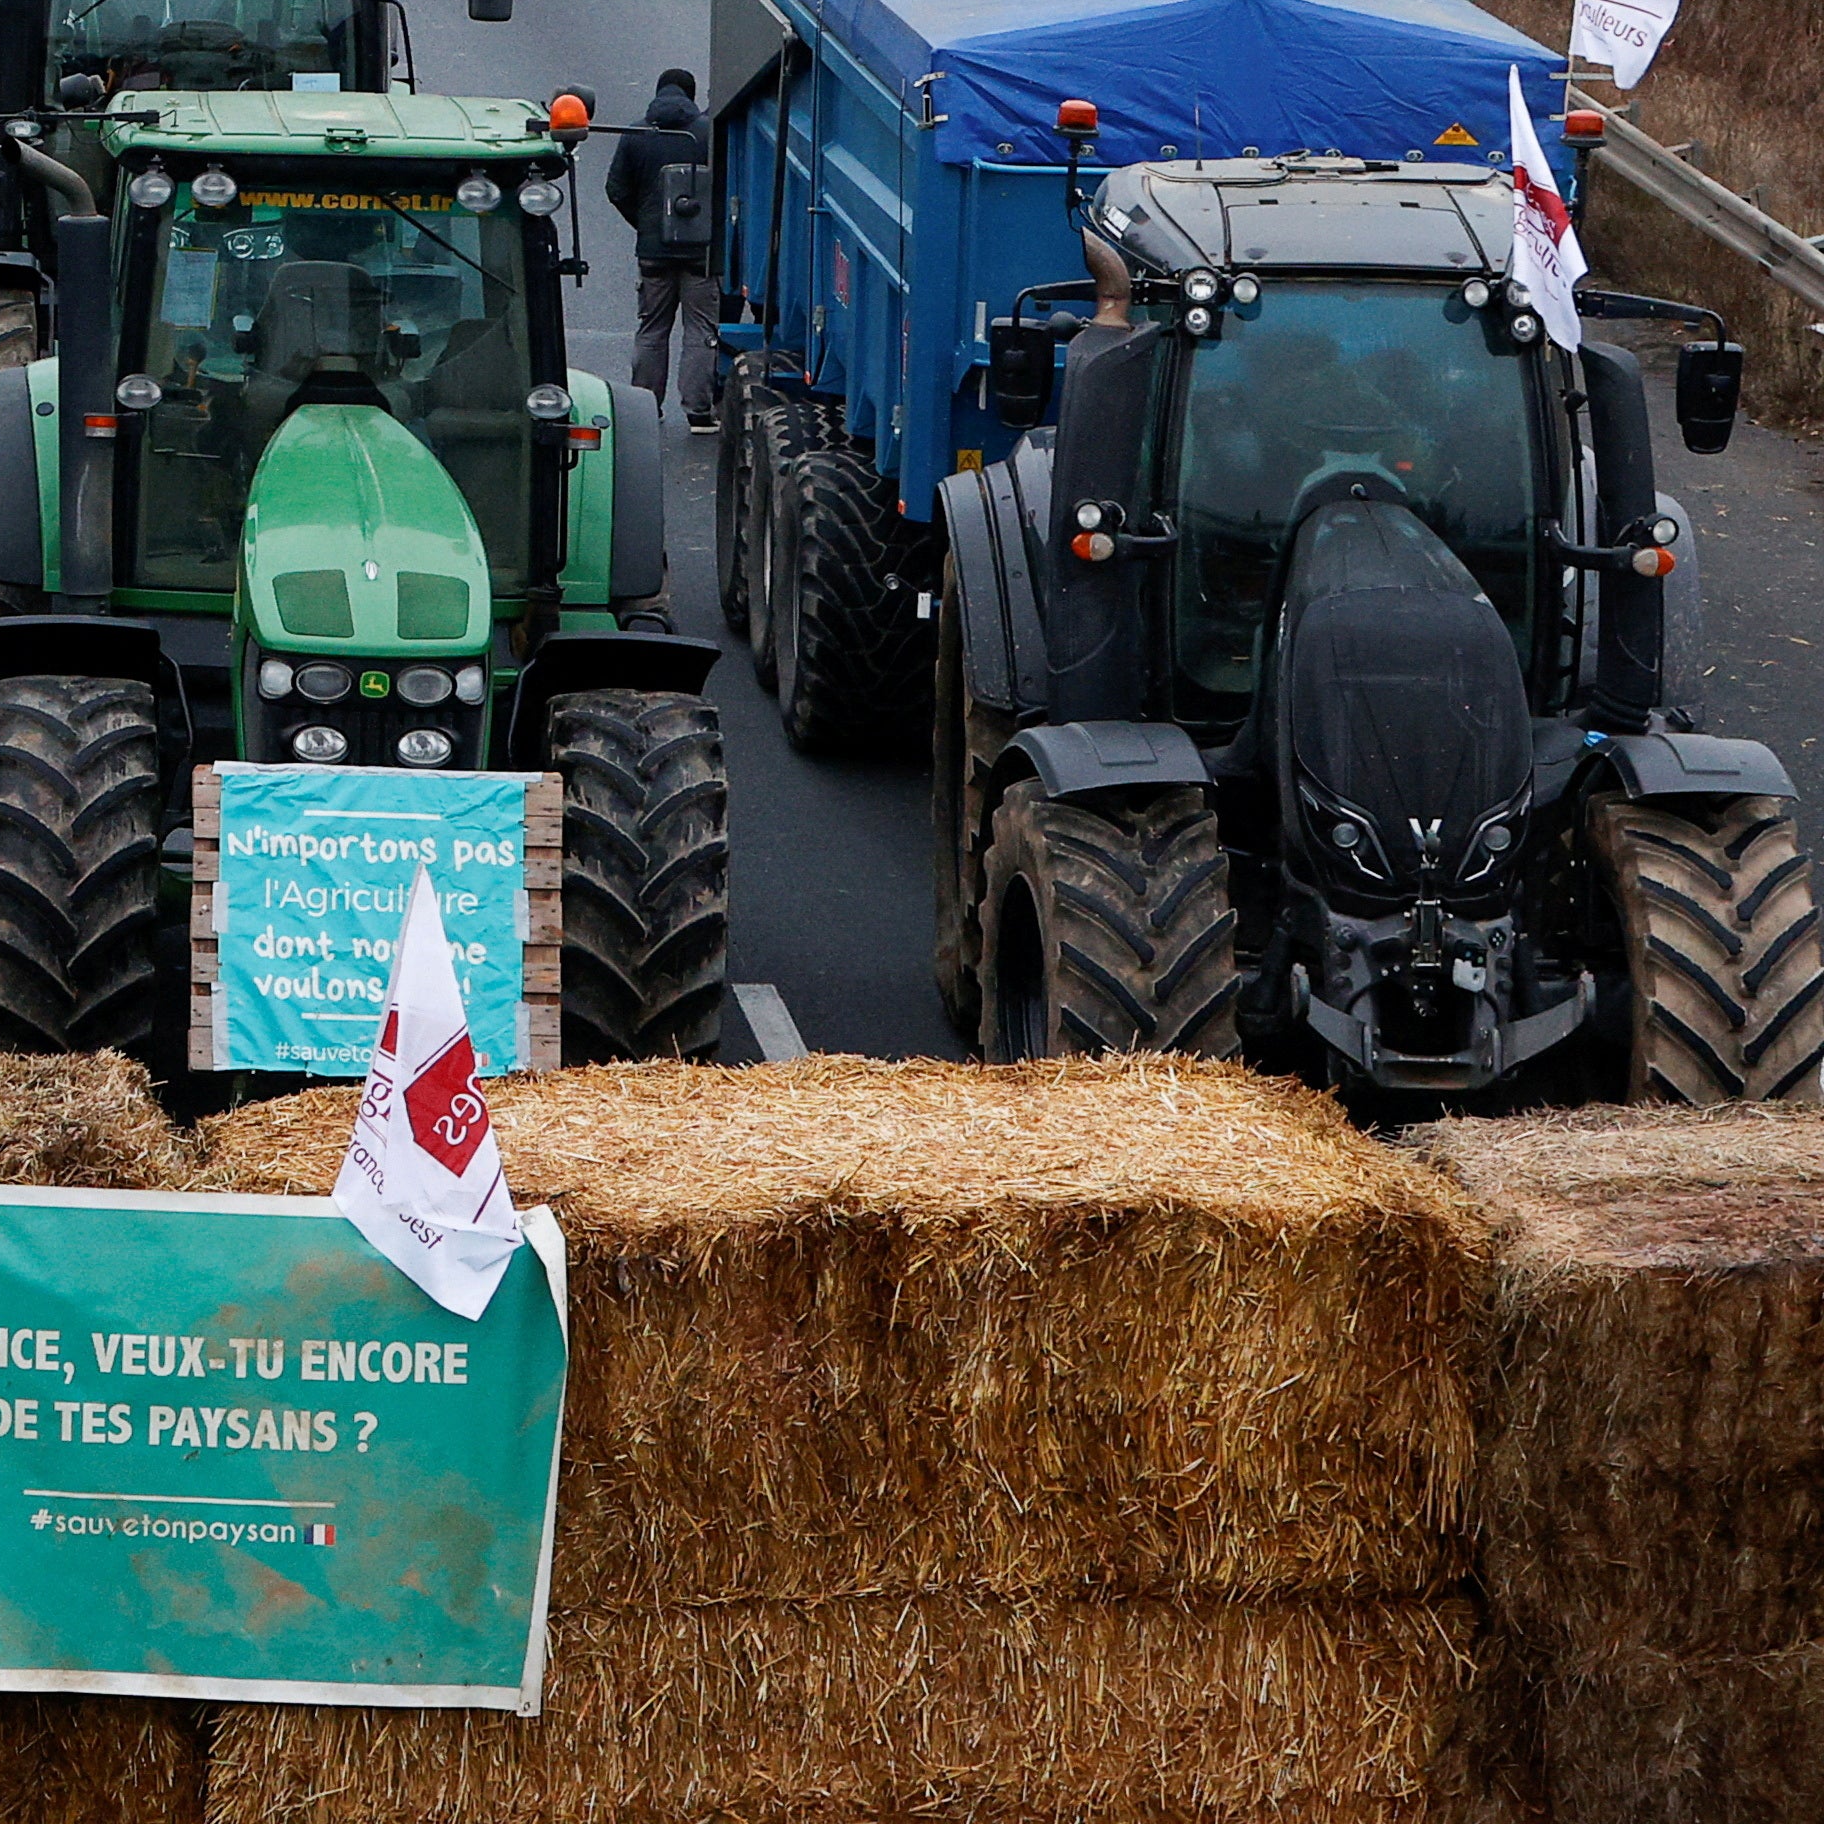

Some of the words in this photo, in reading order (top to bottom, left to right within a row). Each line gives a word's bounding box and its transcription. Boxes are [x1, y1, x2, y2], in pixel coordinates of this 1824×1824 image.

[226, 823, 438, 867] N'importons
[453, 837, 517, 872] pas
[265, 877, 480, 918] l'Agriculre
[252, 924, 336, 962] dont
[352, 936, 400, 963] no
[252, 966, 386, 1003] voulons
[273, 1042, 374, 1064] #sauveto
[92, 1331, 285, 1380] VEUX-TU
[299, 1339, 470, 1386] ENCORE
[53, 1401, 131, 1446] TES
[147, 1405, 338, 1453] PAYSANS
[354, 1411, 378, 1454] ?
[29, 1507, 296, 1547] #sauvetonpaysan
